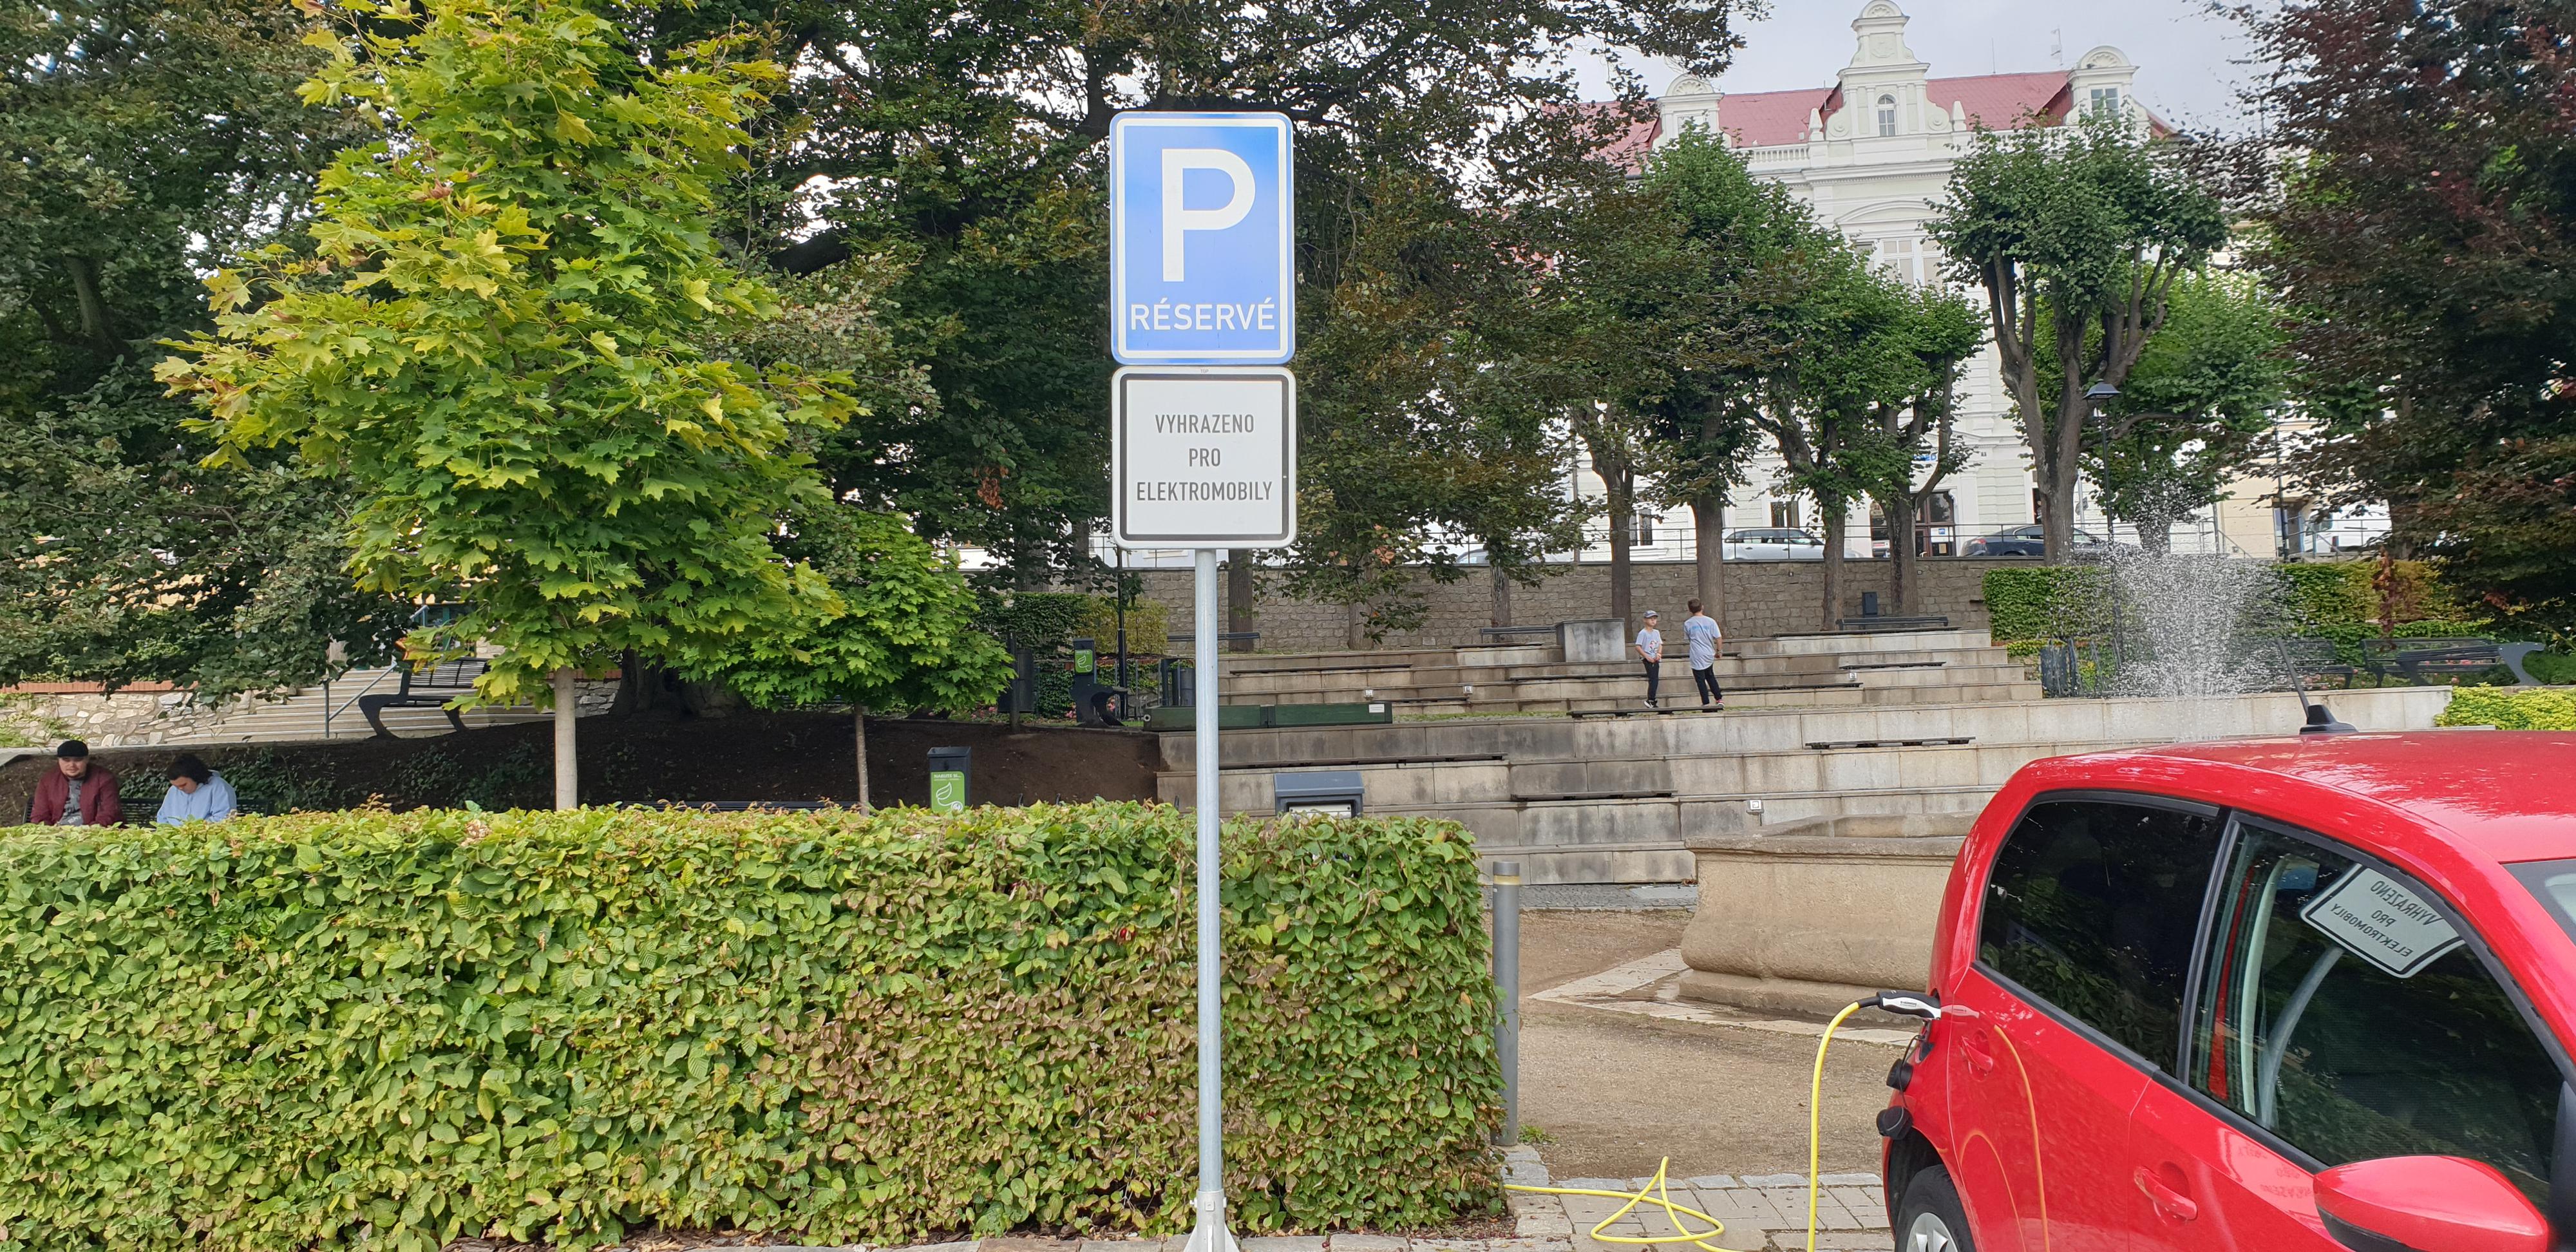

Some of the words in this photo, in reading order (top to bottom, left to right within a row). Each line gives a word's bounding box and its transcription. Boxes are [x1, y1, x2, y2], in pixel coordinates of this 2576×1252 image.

[1162, 149, 1255, 281] P
[1131, 298, 1275, 330] RÉSERVÉ
[1155, 414, 1255, 433] VYHRAZENO
[1189, 448, 1221, 467] PRO
[1137, 481, 1273, 502] ELEKTROMOBILY
